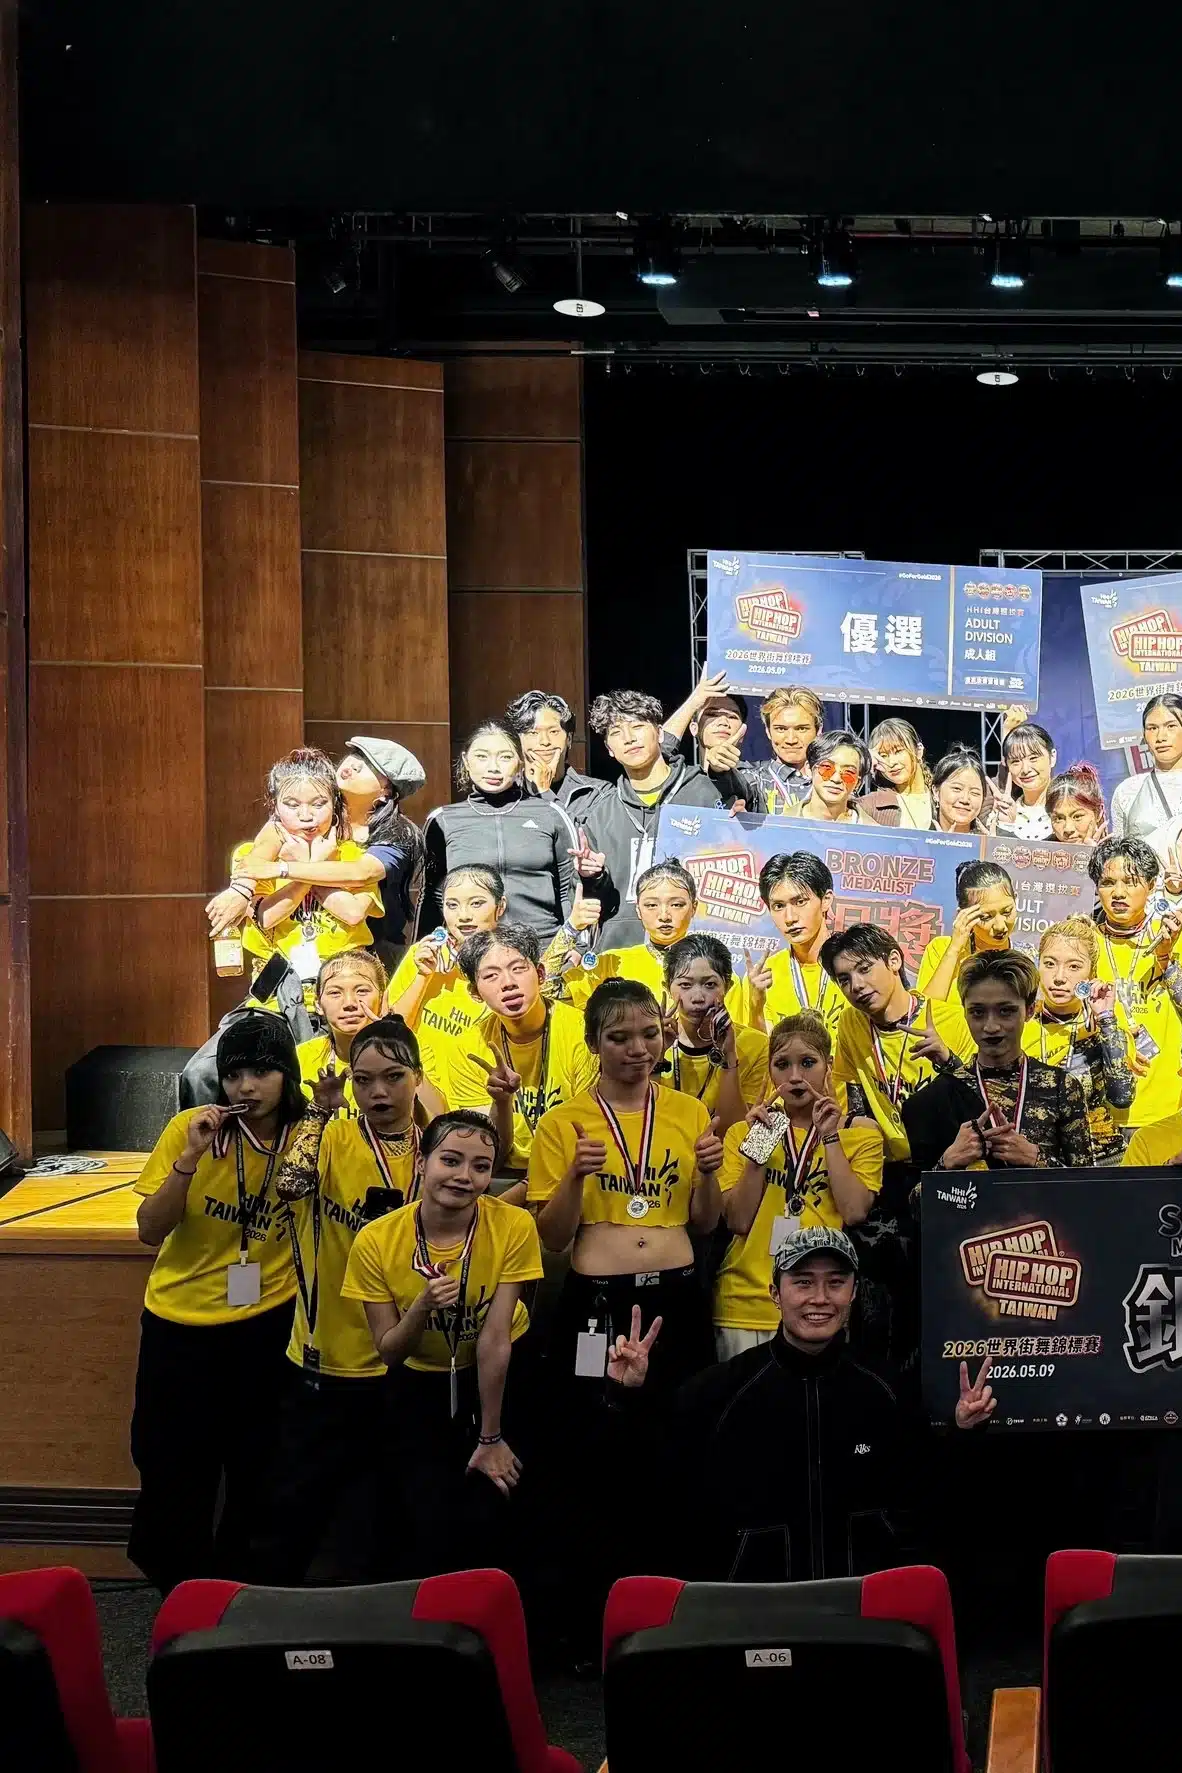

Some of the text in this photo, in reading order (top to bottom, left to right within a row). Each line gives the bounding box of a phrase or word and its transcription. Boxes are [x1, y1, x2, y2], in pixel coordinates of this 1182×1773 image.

[754, 607, 797, 626] HIP HOP
[965, 619, 1001, 630] ADULT
[756, 631, 788, 645] TAIWAN
[840, 612, 923, 656] 優選
[965, 631, 1013, 644] DIVISION
[1134, 636, 1156, 650] HIP
[964, 648, 996, 662] 成人組
[748, 665, 786, 675] 2026.05.09
[1140, 661, 1177, 672] TAIWAN
[825, 849, 936, 884] BRONZE
[706, 874, 733, 894] HIP
[841, 875, 916, 897] MEDALIST
[1015, 880, 1081, 897] I台灣選拔賽
[706, 904, 751, 924] TAIWAN
[1016, 898, 1044, 914] ULT
[449, 1006, 472, 1026] HHI
[1131, 1006, 1149, 1014] 2026
[422, 1007, 464, 1037] TAIWA
[936, 1190, 967, 1205] TAIWAN
[951, 1186, 966, 1198] HHI
[324, 1195, 361, 1233] TAIW
[245, 1229, 267, 1242] 2026
[993, 1258, 1030, 1280] HIP
[1031, 1261, 1073, 1286] HOP
[992, 1278, 1070, 1298] INTERNATIONAL
[999, 1300, 1057, 1321] TAIWAN
[942, 1335, 1101, 1357] 2026世界街舞錦標賽
[986, 1364, 1055, 1379] 2026.05.09
[293, 1655, 326, 1665] A-08
